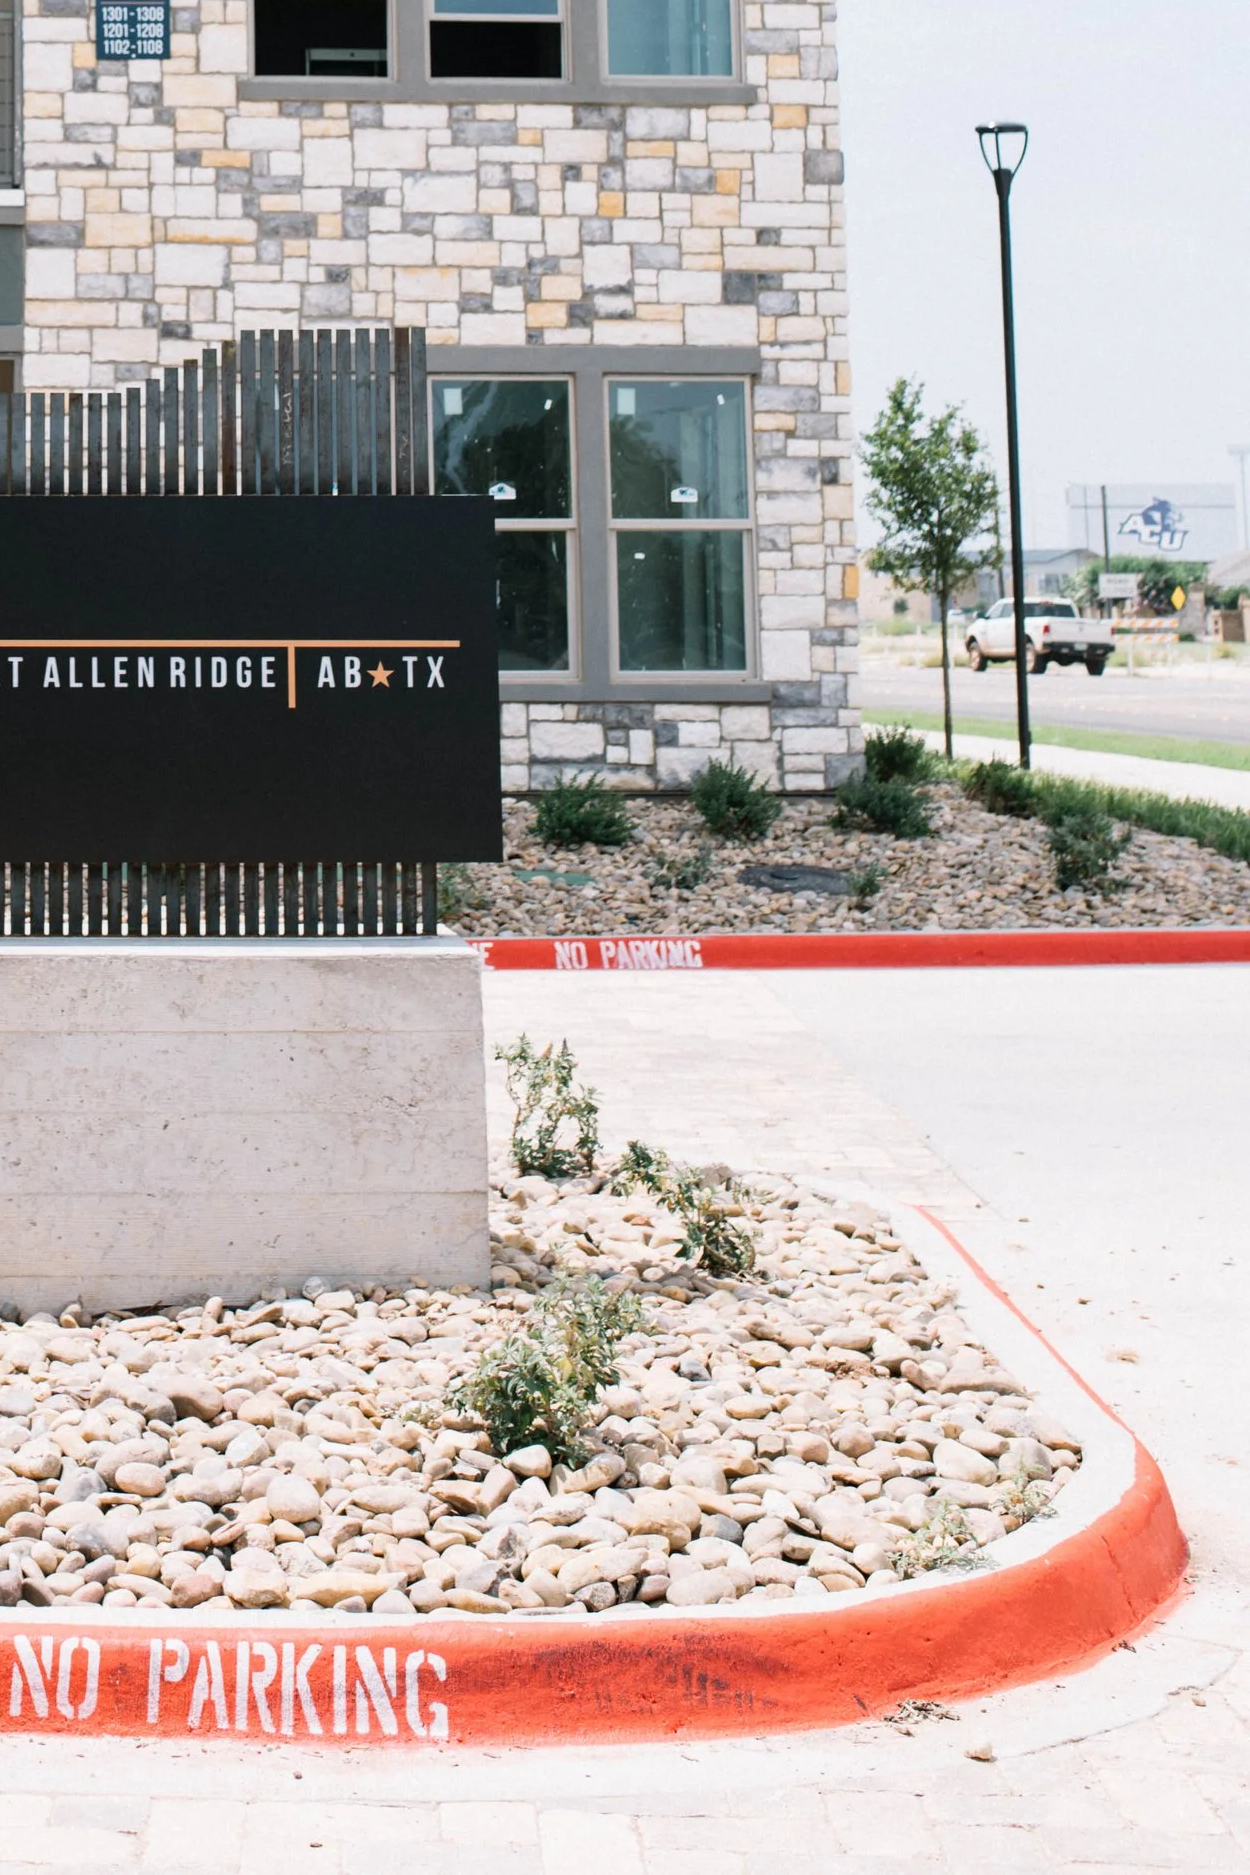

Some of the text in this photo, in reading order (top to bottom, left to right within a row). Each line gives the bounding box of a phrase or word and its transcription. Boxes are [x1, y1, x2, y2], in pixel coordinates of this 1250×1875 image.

[43, 656, 155, 688] ALLEN
[170, 656, 276, 688] RIDGE
[554, 939, 703, 970] NO PARKING
[8, 1634, 450, 1740] NO PARKING
